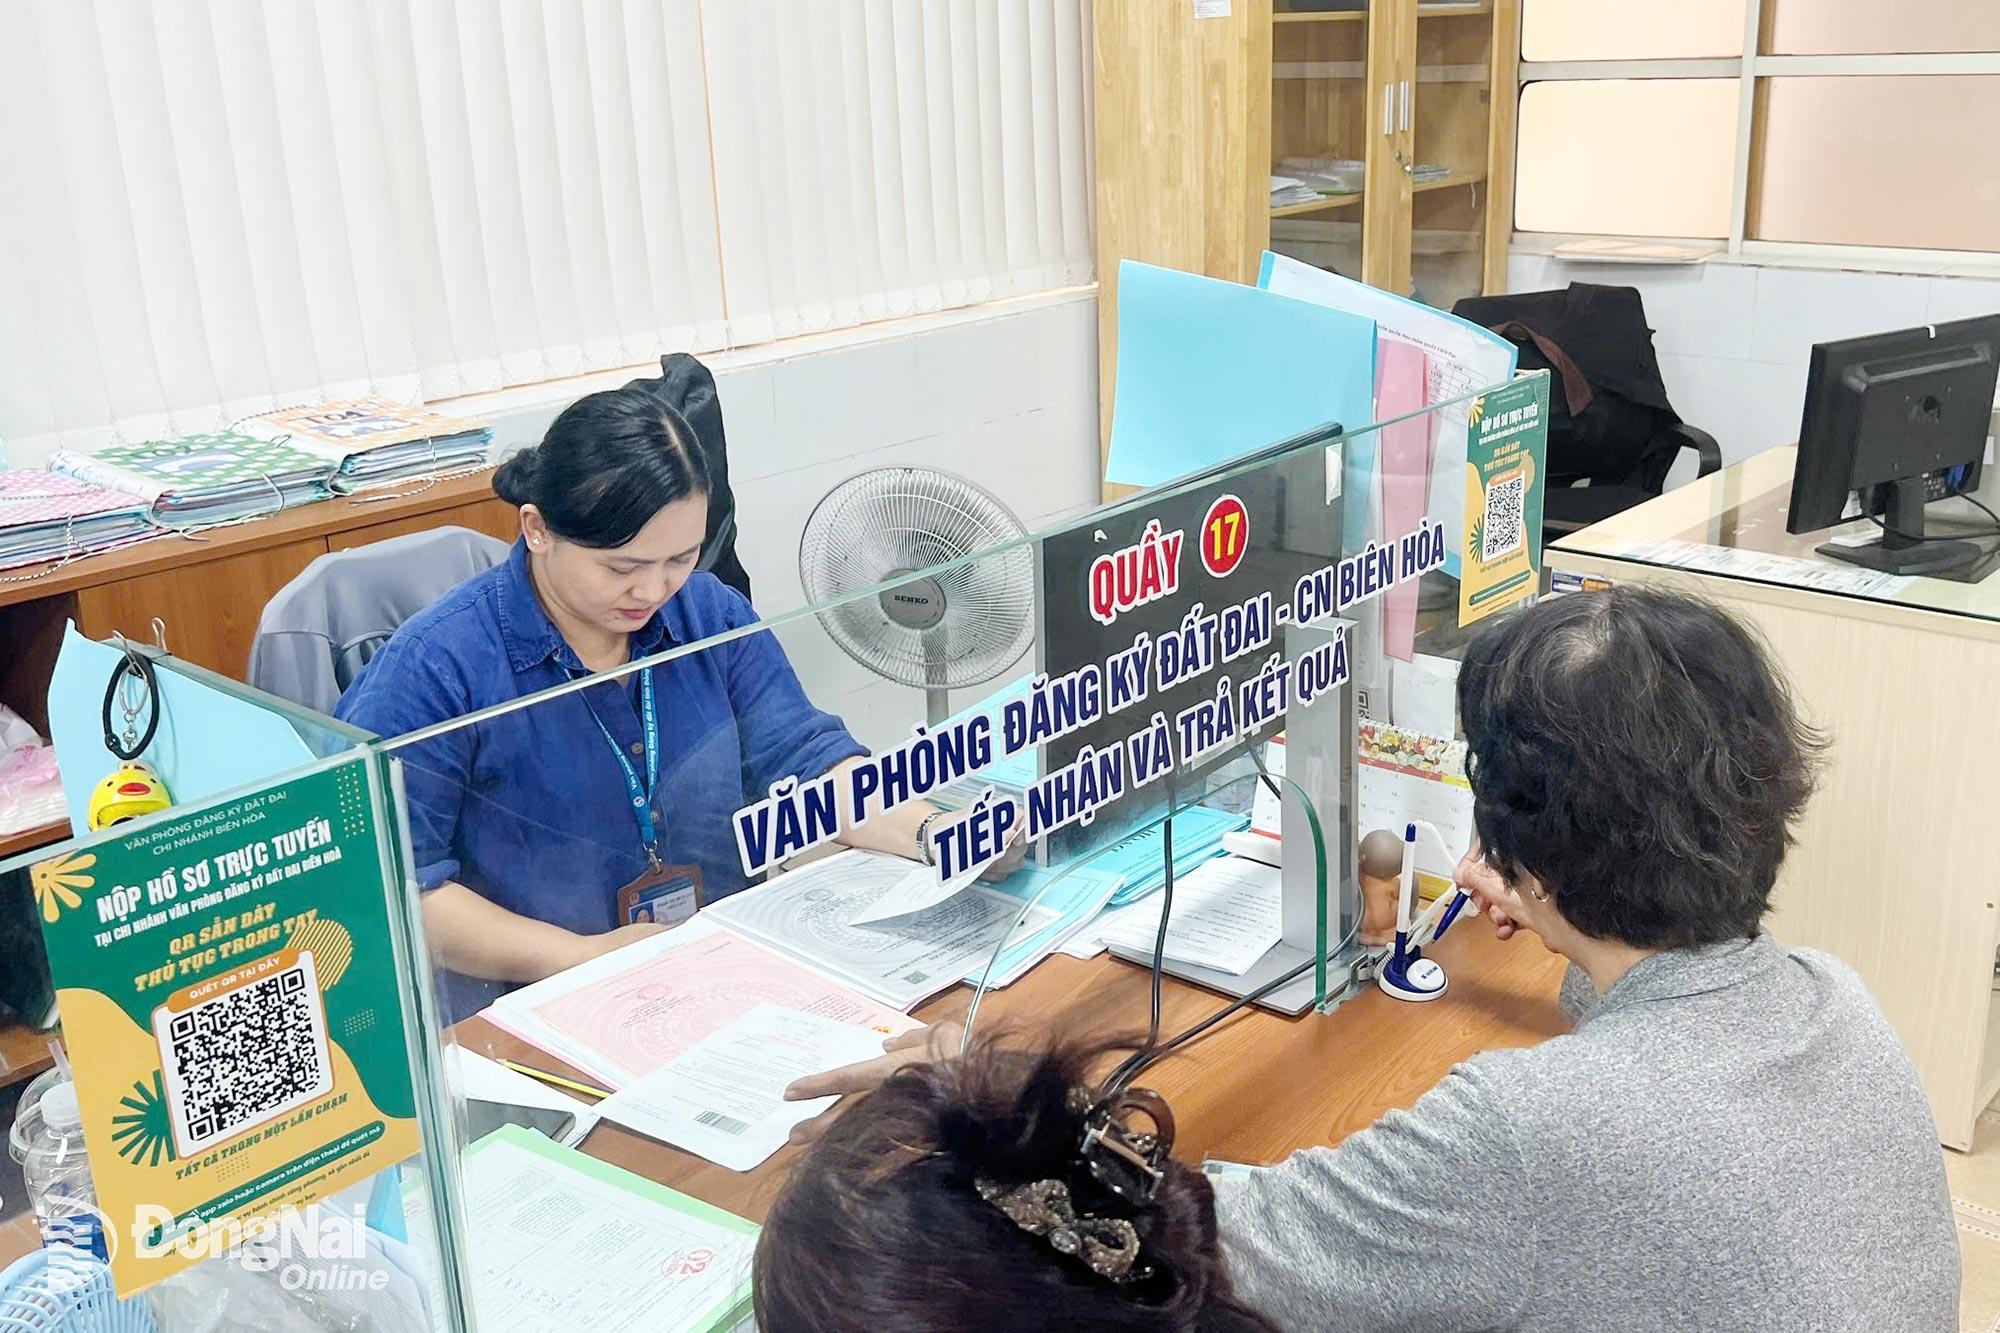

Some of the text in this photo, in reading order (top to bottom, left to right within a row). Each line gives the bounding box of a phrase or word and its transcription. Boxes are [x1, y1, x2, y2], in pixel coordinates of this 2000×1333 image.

[1210, 511, 1241, 561] 17
[1093, 524, 1181, 618] QUẦY
[740, 780, 838, 870] VĂN
[852, 715, 991, 823] PHÒNG
[1003, 669, 1100, 755] ĐĂNG
[1110, 639, 1150, 708] KÝ
[1160, 607, 1216, 685] ĐẤT
[1225, 597, 1270, 655] ĐAI
[1298, 571, 1332, 624] CN
[1340, 543, 1394, 606] BIÊN
[1401, 520, 1445, 578] HÒA
[934, 627, 1348, 882] TIẾP NHẬN VÀ TRẢ KẾT QUẢ
[125, 791, 287, 851] VĂN PHÒNG ĐĂNG KÝ ĐẤT ĐAI
[152, 811, 266, 856] CHI NHÁNH BIÊN HÒA
[96, 816, 332, 923] NỘP HỒ SƠ TRỰC TUYẾN
[94, 930, 112, 947] TẠI
[113, 924, 132, 941] CHI
[132, 910, 168, 934] NHÁNH
[168, 902, 190, 920] VĂN
[190, 890, 224, 912] PHÒNG
[224, 880, 250, 901] ĐĂNG
[251, 873, 264, 891] KÝ
[284, 862, 301, 878] ĐAI
[301, 854, 323, 872] BIÊN
[169, 932, 196, 955] QR
[240, 902, 276, 930] ĐÂY
[134, 908, 317, 992] THỦ TỤC TRONG TAY
[189, 957, 281, 999] QUÉT QR TẠI ĐÂY
[176, 1160, 201, 1180] TẤT
[221, 1133, 262, 1159] TRONG
[264, 1120, 289, 1140] MỘT
[200, 1206, 217, 1218] app
[217, 1198, 234, 1209] zalo
[255, 1172, 285, 1191] camera
